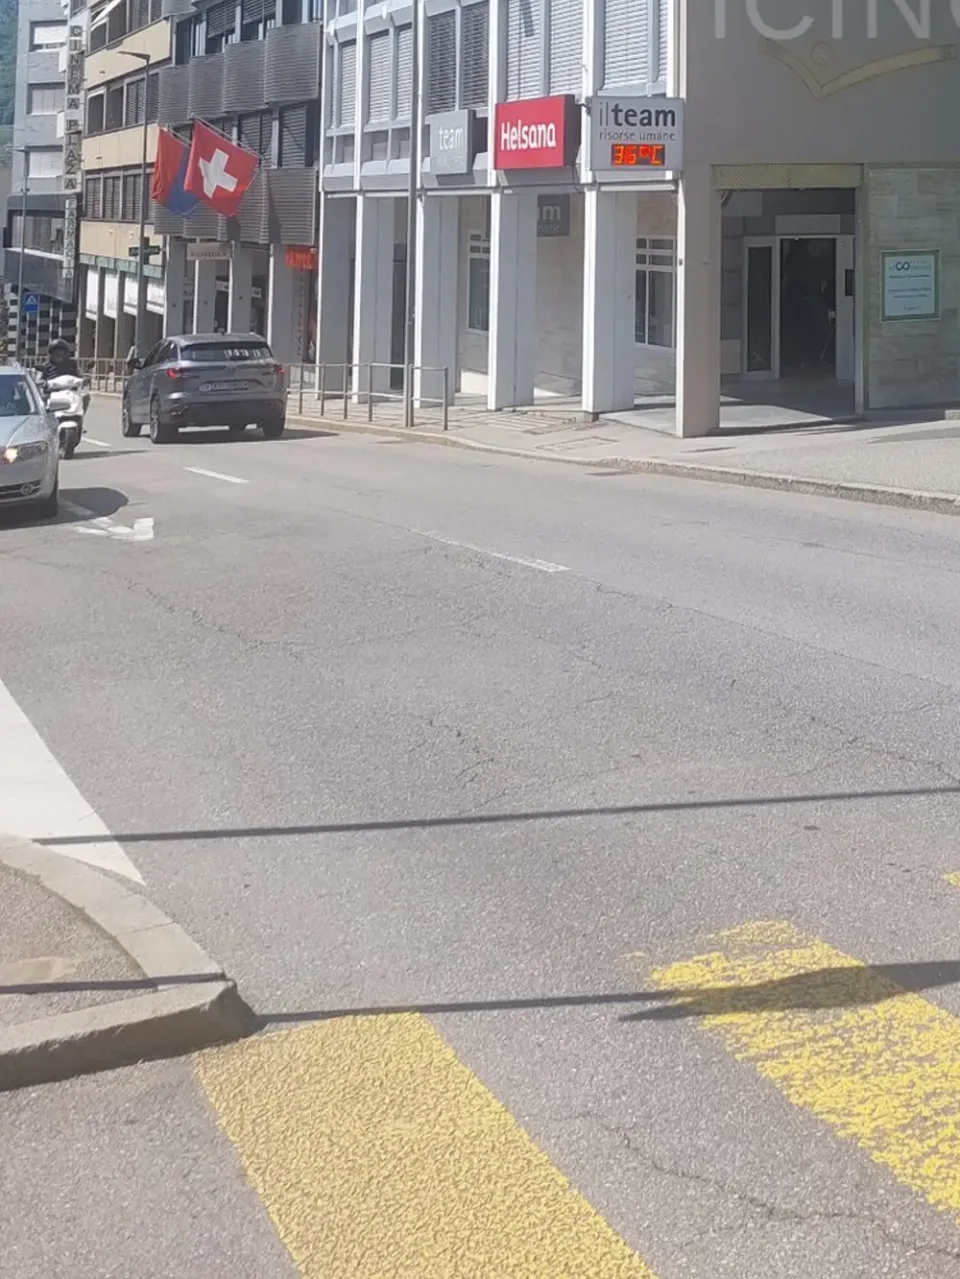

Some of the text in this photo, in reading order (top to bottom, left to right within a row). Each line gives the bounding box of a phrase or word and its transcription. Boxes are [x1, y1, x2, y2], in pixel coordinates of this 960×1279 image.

[65, 26, 83, 190] CINEMA PLAZA
[501, 120, 556, 150] Helsana
[599, 128, 675, 141] risorse umane
